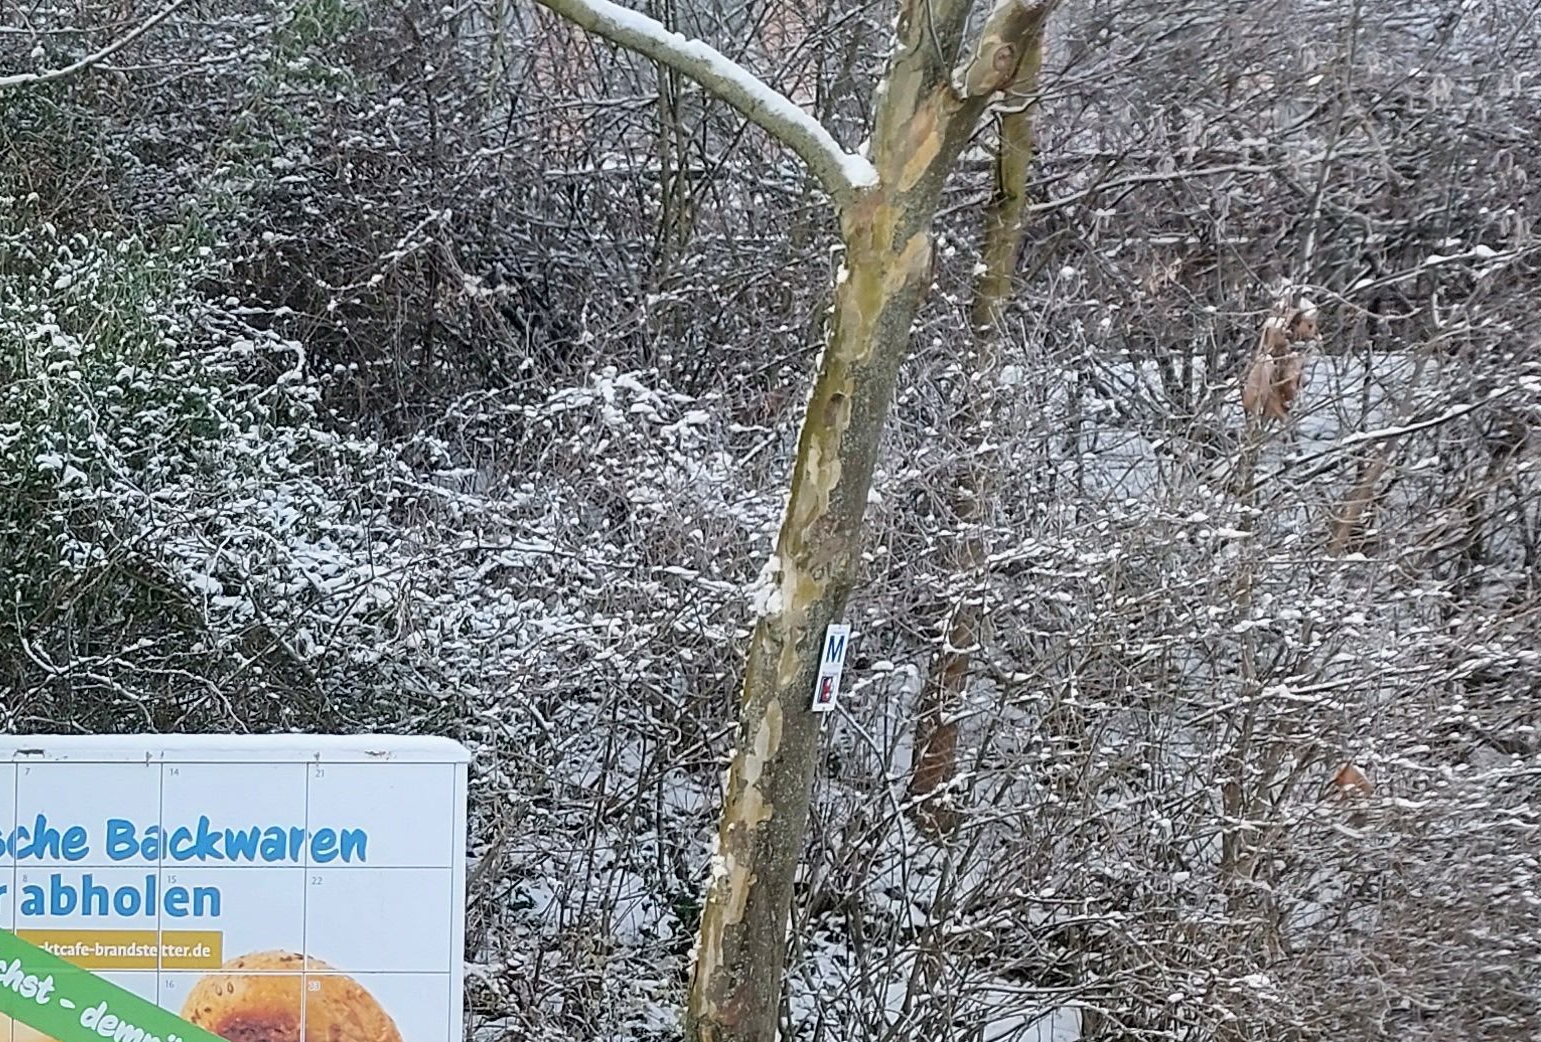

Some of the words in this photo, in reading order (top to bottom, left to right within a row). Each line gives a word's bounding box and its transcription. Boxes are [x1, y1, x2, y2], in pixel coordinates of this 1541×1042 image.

[825, 635, 846, 663] M
[105, 816, 369, 864] Backwaren
[20, 873, 222, 917] abholen
[38, 942, 211, 958] ktcafe-brandstetter.de
